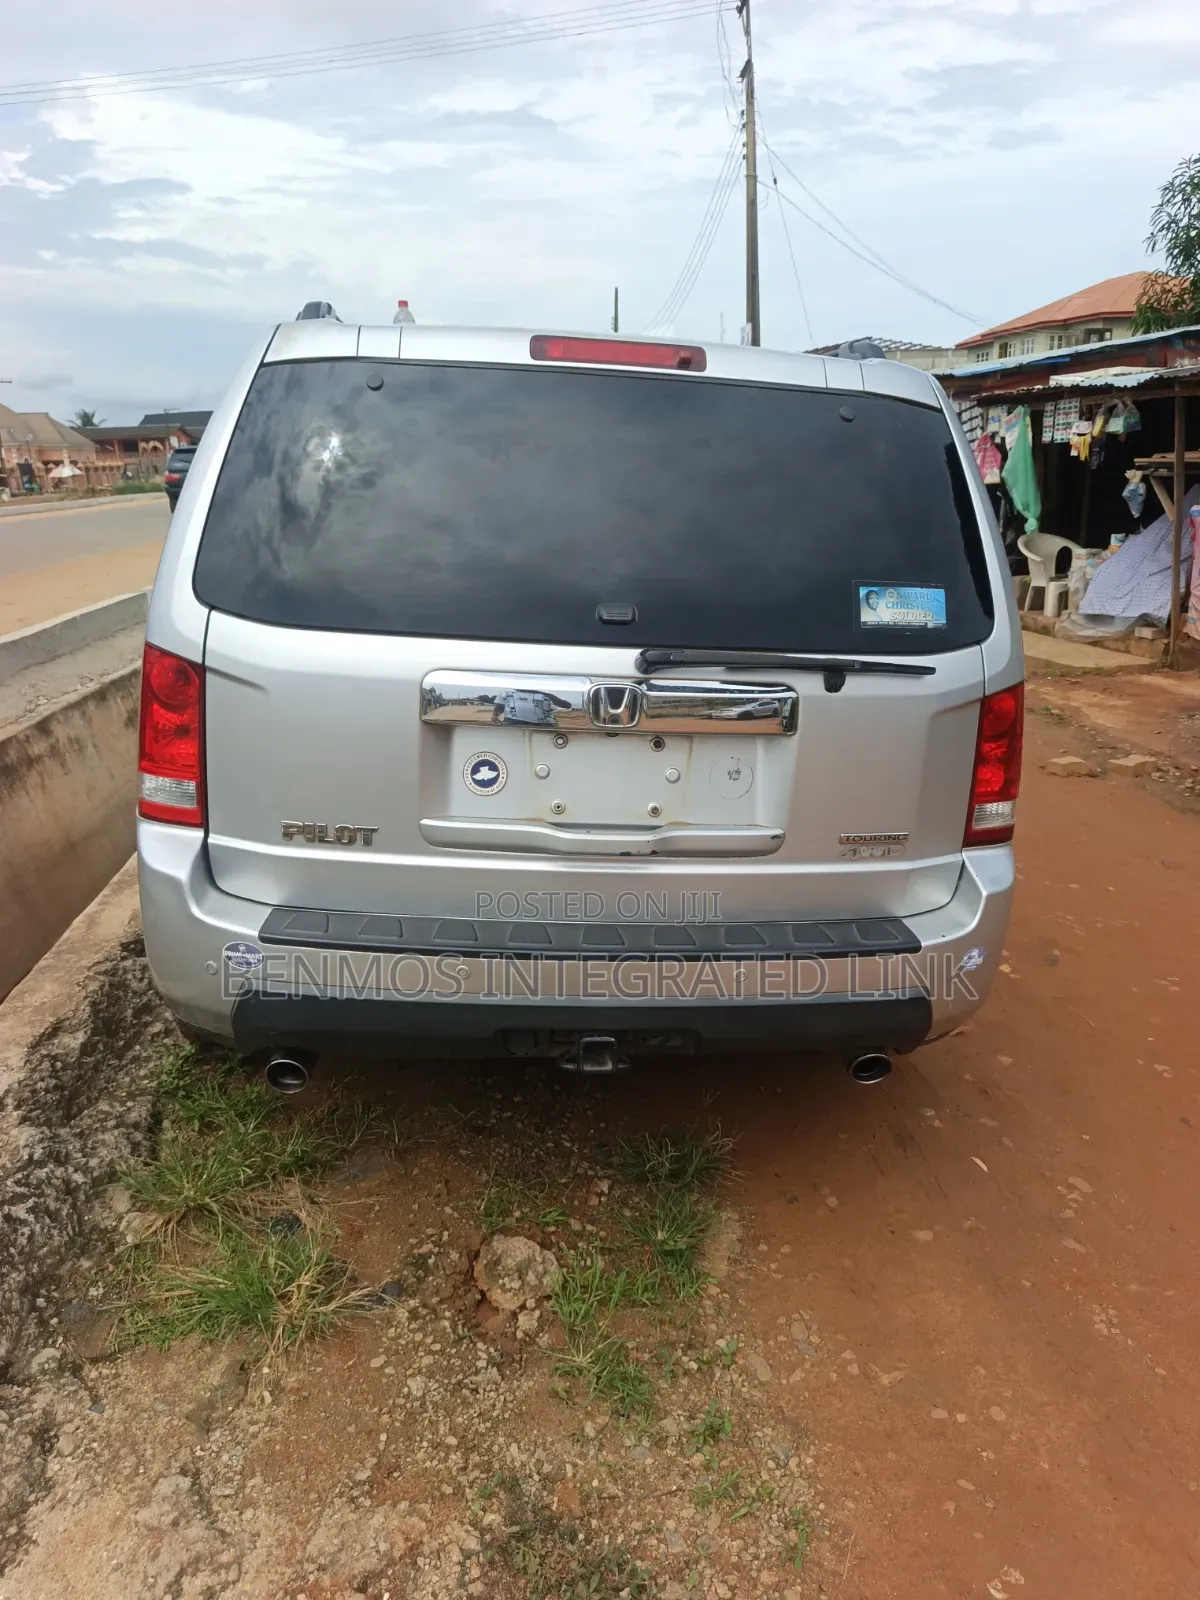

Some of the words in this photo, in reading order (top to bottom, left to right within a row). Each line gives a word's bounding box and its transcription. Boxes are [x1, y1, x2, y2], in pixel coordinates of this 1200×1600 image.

[885, 600, 936, 610] CHRISTIAN
[889, 611, 934, 622] SOLDIER
[281, 820, 379, 847] PILOT
[842, 833, 908, 843] TOURING
